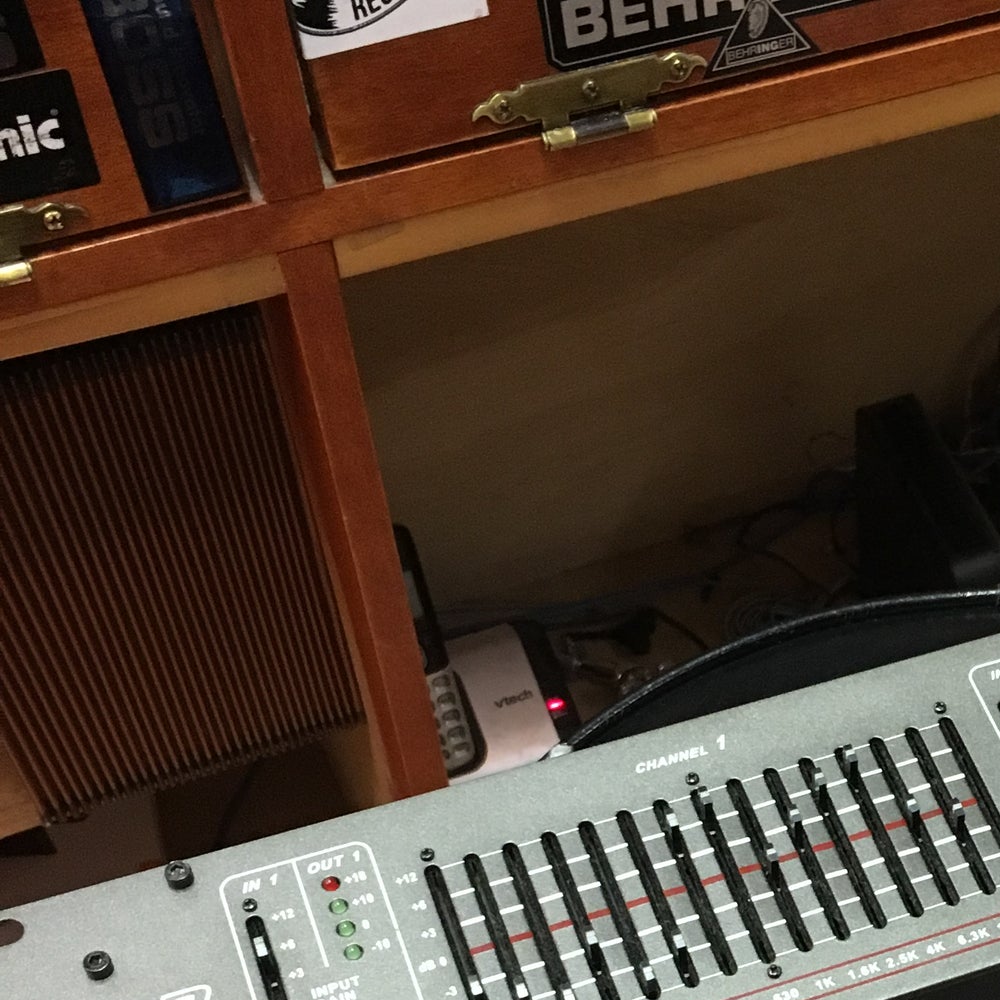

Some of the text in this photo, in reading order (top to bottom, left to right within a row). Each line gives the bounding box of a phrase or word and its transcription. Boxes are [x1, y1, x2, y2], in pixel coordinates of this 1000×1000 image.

[728, 37, 793, 60] BEHRINGER
[635, 734, 725, 773] CHANNEL 1
[307, 850, 360, 874] OUT 1
[243, 873, 277, 894] IN 1
[395, 872, 418, 885] +12
[272, 908, 295, 921] +12
[421, 928, 436, 938] +3
[815, 976, 836, 990] 1K
[847, 962, 881, 979] 1.6K
[886, 950, 919, 968] 2.5K
[927, 941, 946, 954] 4K
[957, 928, 990, 945] 6.3K
[288, 968, 304, 979] +3
[311, 975, 359, 999] INPUT
[445, 986, 457, 996] -3
